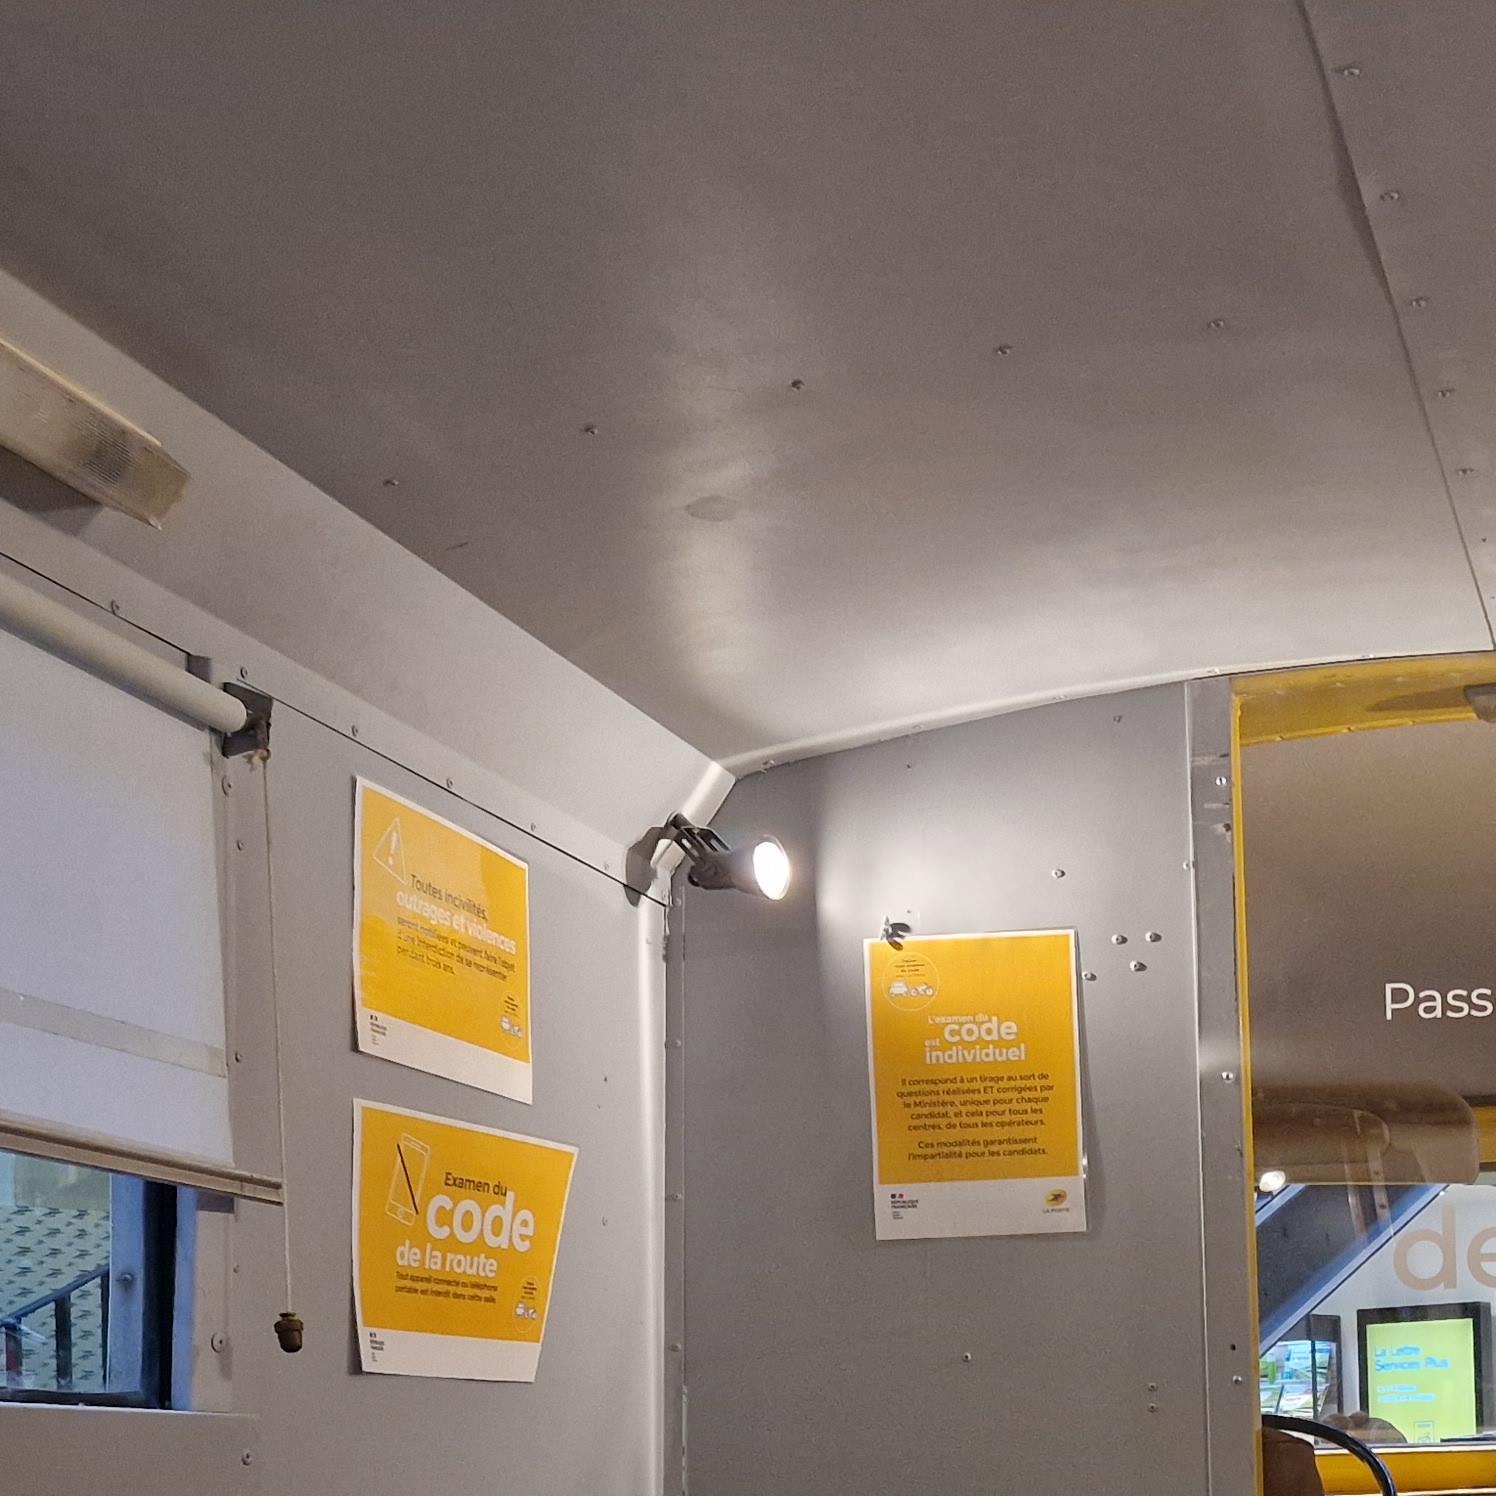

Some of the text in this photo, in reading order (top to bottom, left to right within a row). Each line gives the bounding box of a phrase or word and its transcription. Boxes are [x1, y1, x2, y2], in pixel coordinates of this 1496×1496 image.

[411, 874, 443, 901] Toutes
[396, 891, 517, 955] outrages et violences
[944, 1015, 1018, 1043] code
[925, 1043, 1026, 1065] individuel
[908, 1075, 958, 1088] correspond
[979, 1073, 1005, 1085] tirage
[983, 1085, 995, 1095] ET
[993, 1096, 1014, 1106] pour
[985, 1108, 1007, 1119] pour
[1008, 1107, 1028, 1116] tous
[959, 1119, 979, 1129] tous
[917, 1140, 934, 1150] Ces
[965, 1148, 986, 1160] pour
[444, 1172, 508, 1198] Examen du
[425, 1191, 536, 1253] code
[396, 1239, 498, 1278] de la route
